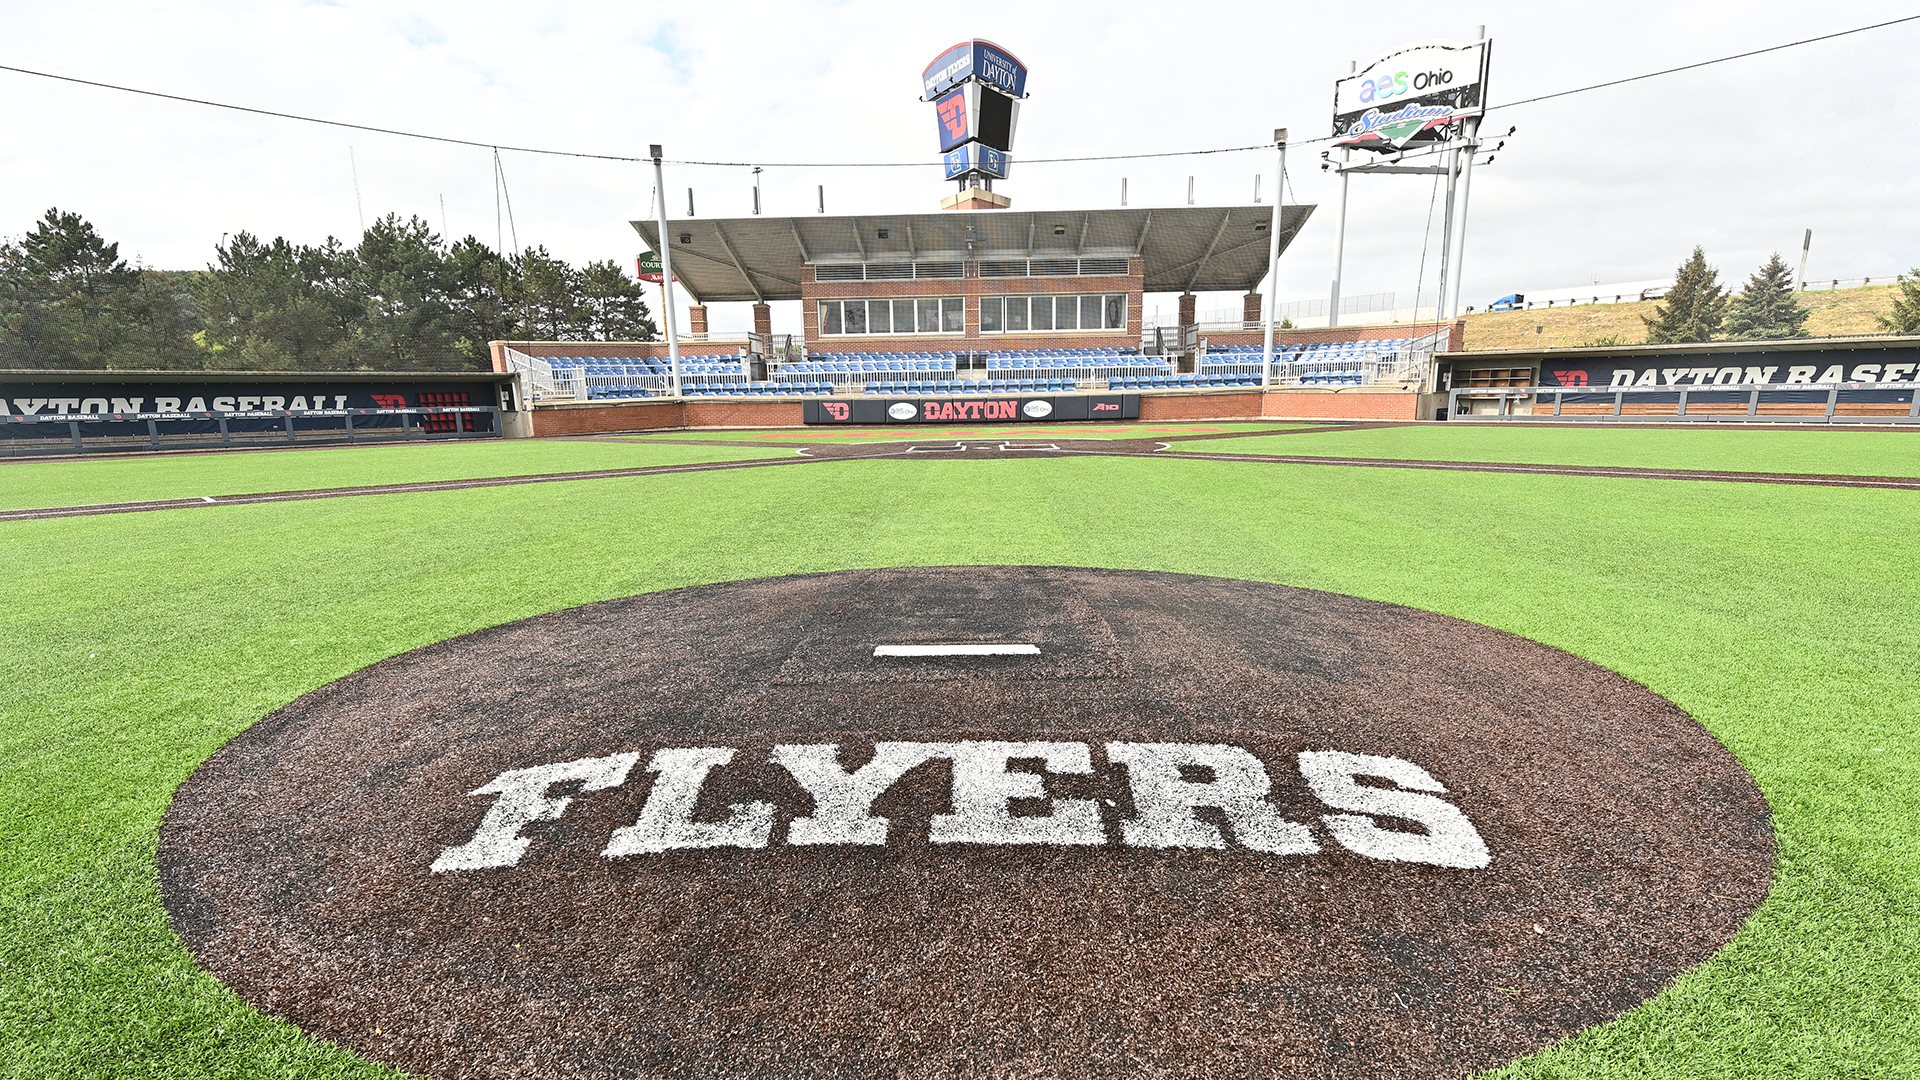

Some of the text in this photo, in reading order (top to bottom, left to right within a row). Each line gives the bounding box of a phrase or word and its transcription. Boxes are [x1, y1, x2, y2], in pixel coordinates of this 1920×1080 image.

[983, 49, 1018, 76] UNIVERSITY of
[925, 68, 948, 91] DAYTON
[982, 60, 1017, 91] DAYTON
[1359, 68, 1453, 103] aes Ohio
[1349, 104, 1454, 135] Stadium
[1609, 366, 1779, 386] DAYTON
[1785, 363, 1920, 384] BASE
[890, 407, 904, 415] aes
[923, 401, 1018, 420] DAYTON
[1025, 405, 1039, 413] aes
[1092, 403, 1120, 411] A10
[431, 739, 1491, 873] FLYERS
